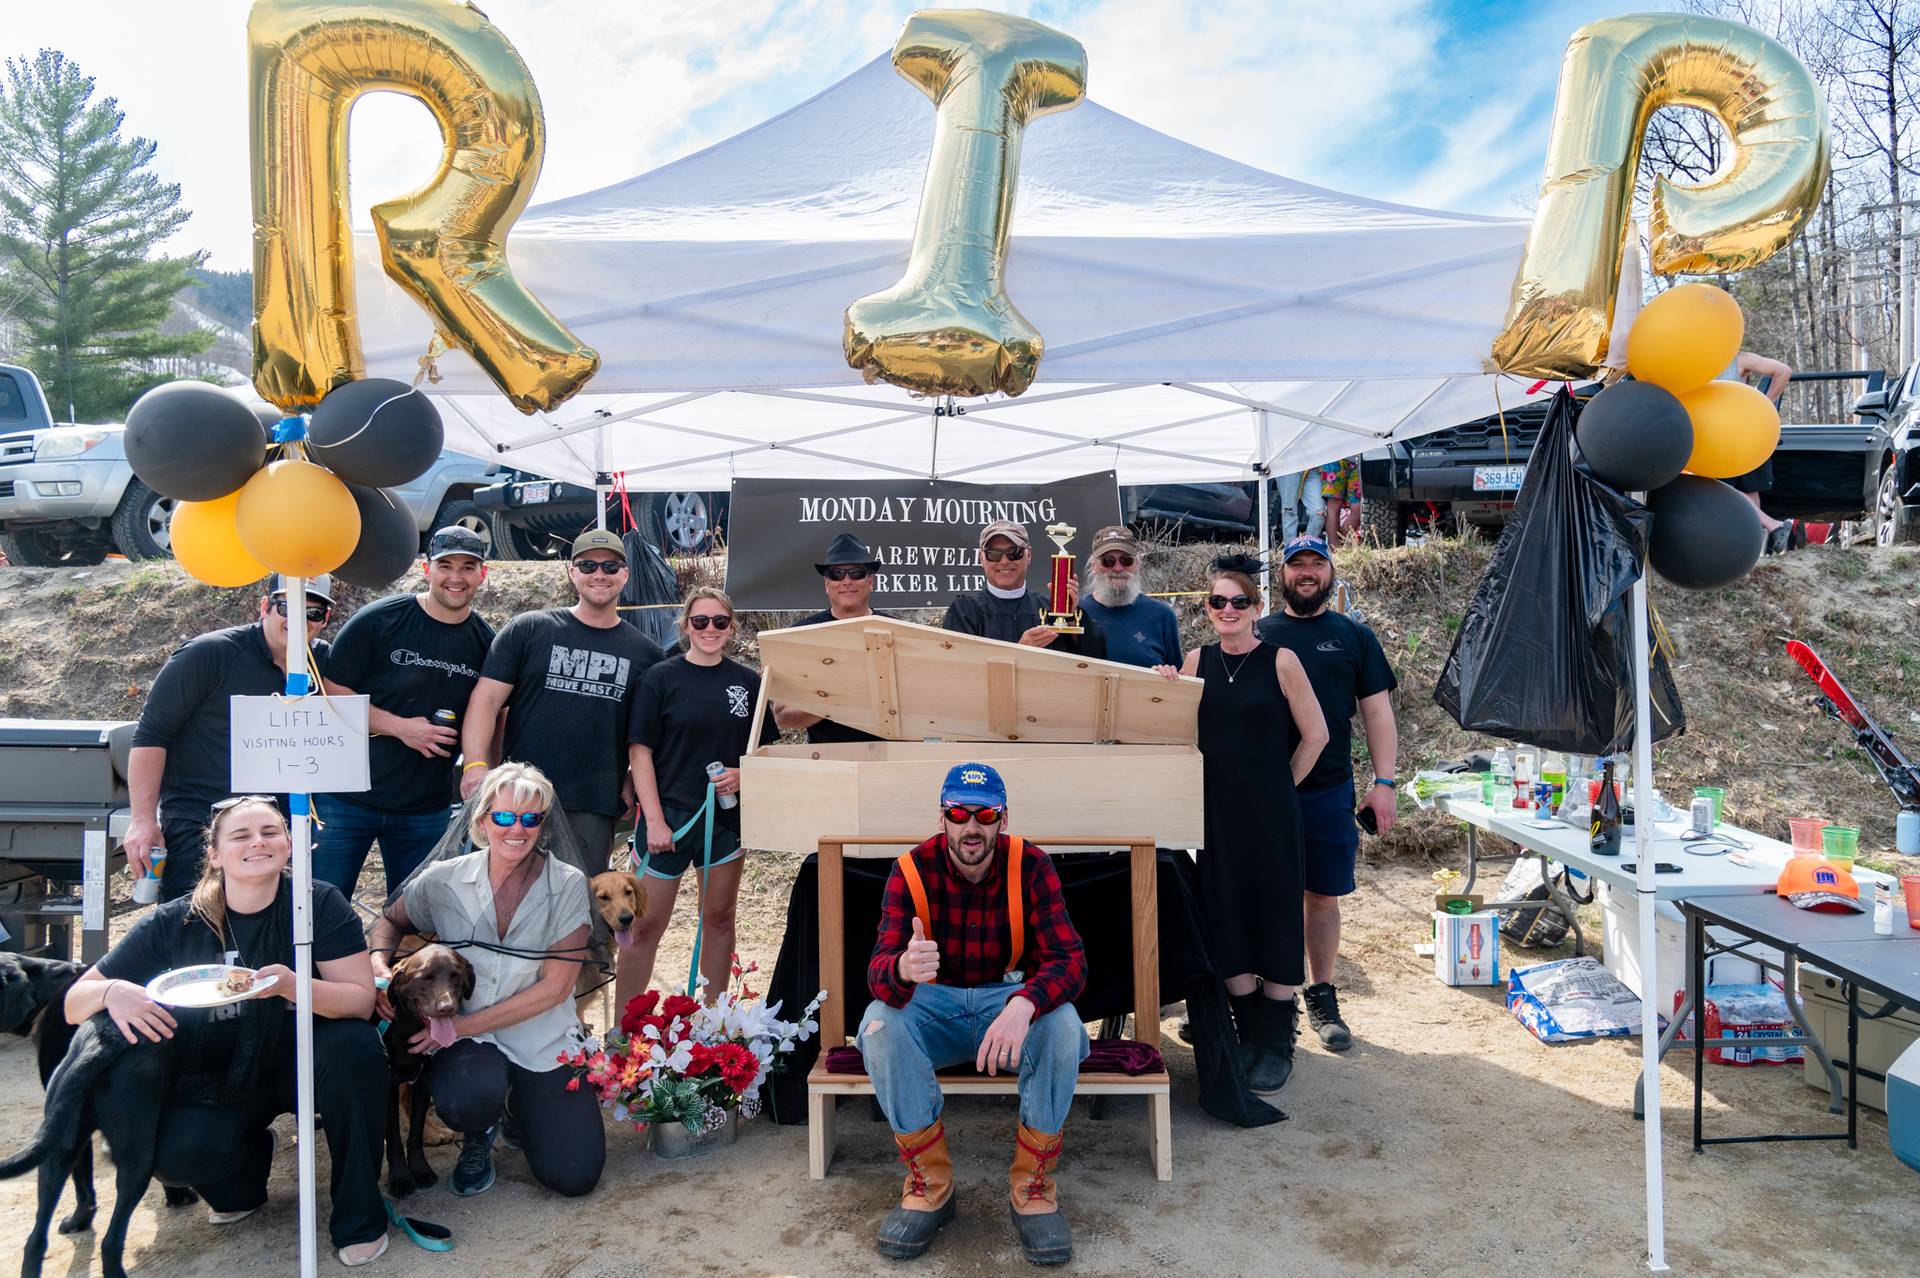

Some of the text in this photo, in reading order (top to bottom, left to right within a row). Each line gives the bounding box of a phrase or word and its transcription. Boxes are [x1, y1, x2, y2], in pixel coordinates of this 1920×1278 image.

[247, 0, 1833, 416] R I P
[799, 496, 1057, 525] MONDAY MOURNING
[874, 573, 986, 593] RKER LIF
[548, 644, 631, 687] MPI
[545, 677, 625, 699] MOVE PAST IT
[269, 711, 329, 728] LIFT 1
[242, 735, 345, 749] VISITING HOURS
